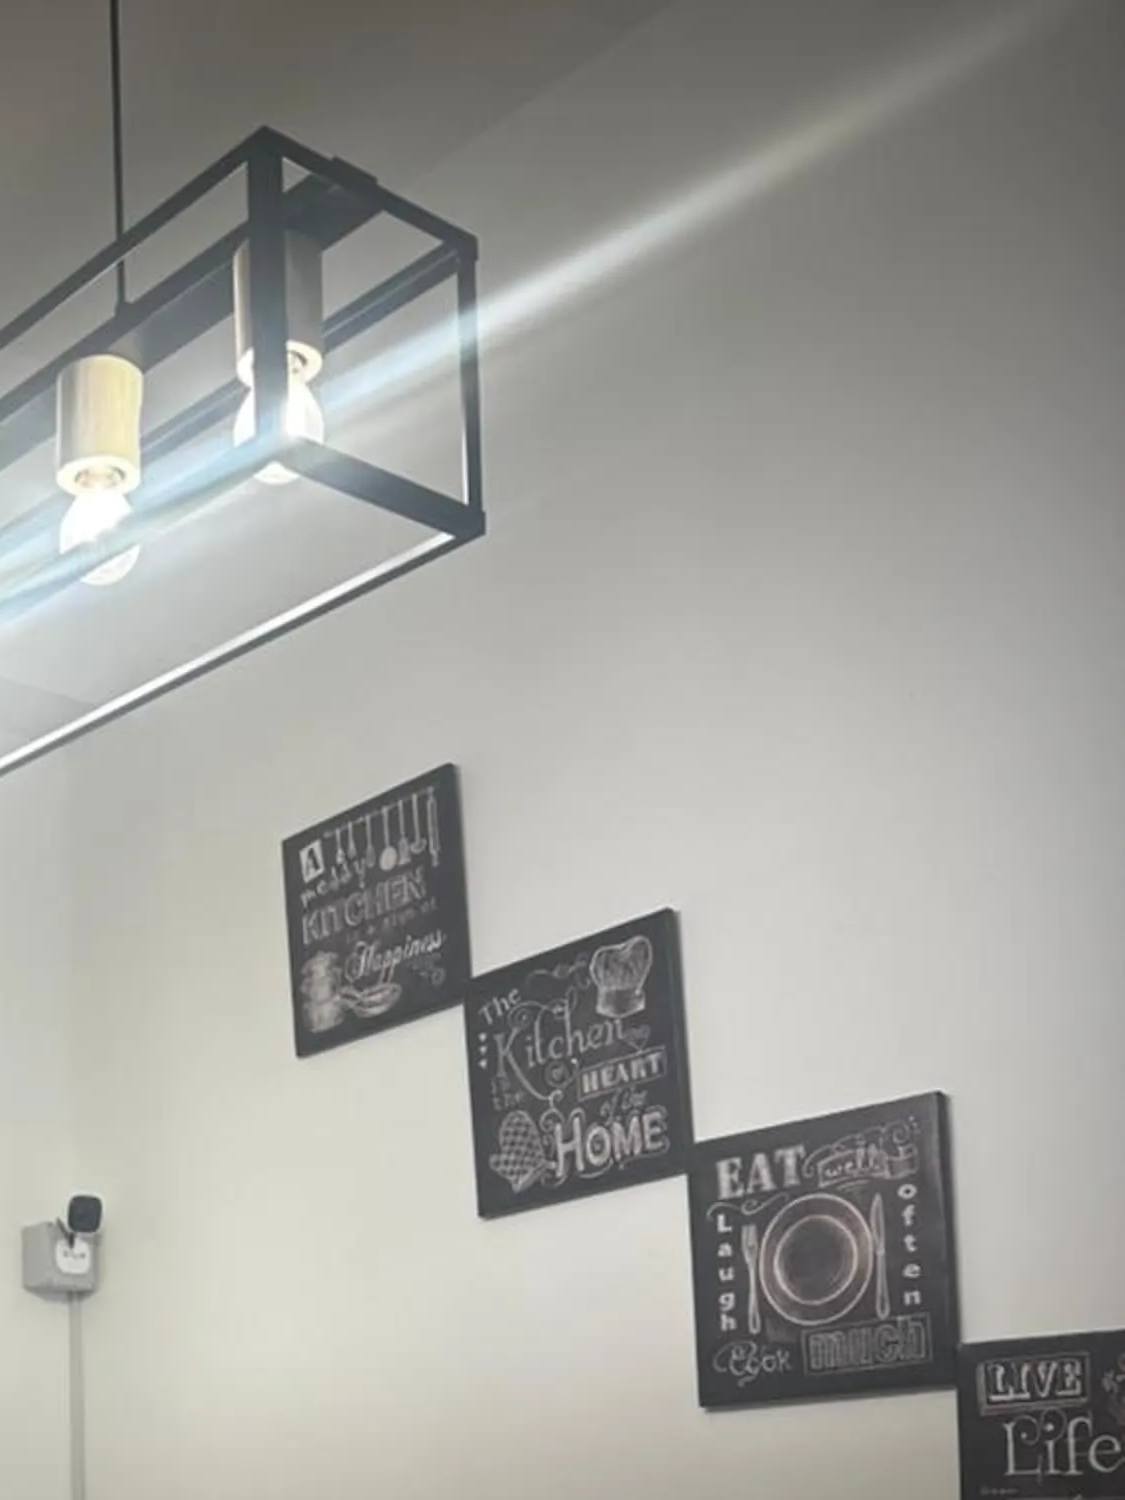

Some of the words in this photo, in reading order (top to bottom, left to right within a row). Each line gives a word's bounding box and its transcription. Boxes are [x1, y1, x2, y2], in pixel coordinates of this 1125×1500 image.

[479, 988, 521, 1024] The
[493, 986, 626, 1100] Kitchen
[581, 1052, 662, 1093] HEART
[552, 1109, 669, 1178] HOME
[716, 1145, 807, 1199] EAT
[1003, 1410, 1124, 1478] Life
